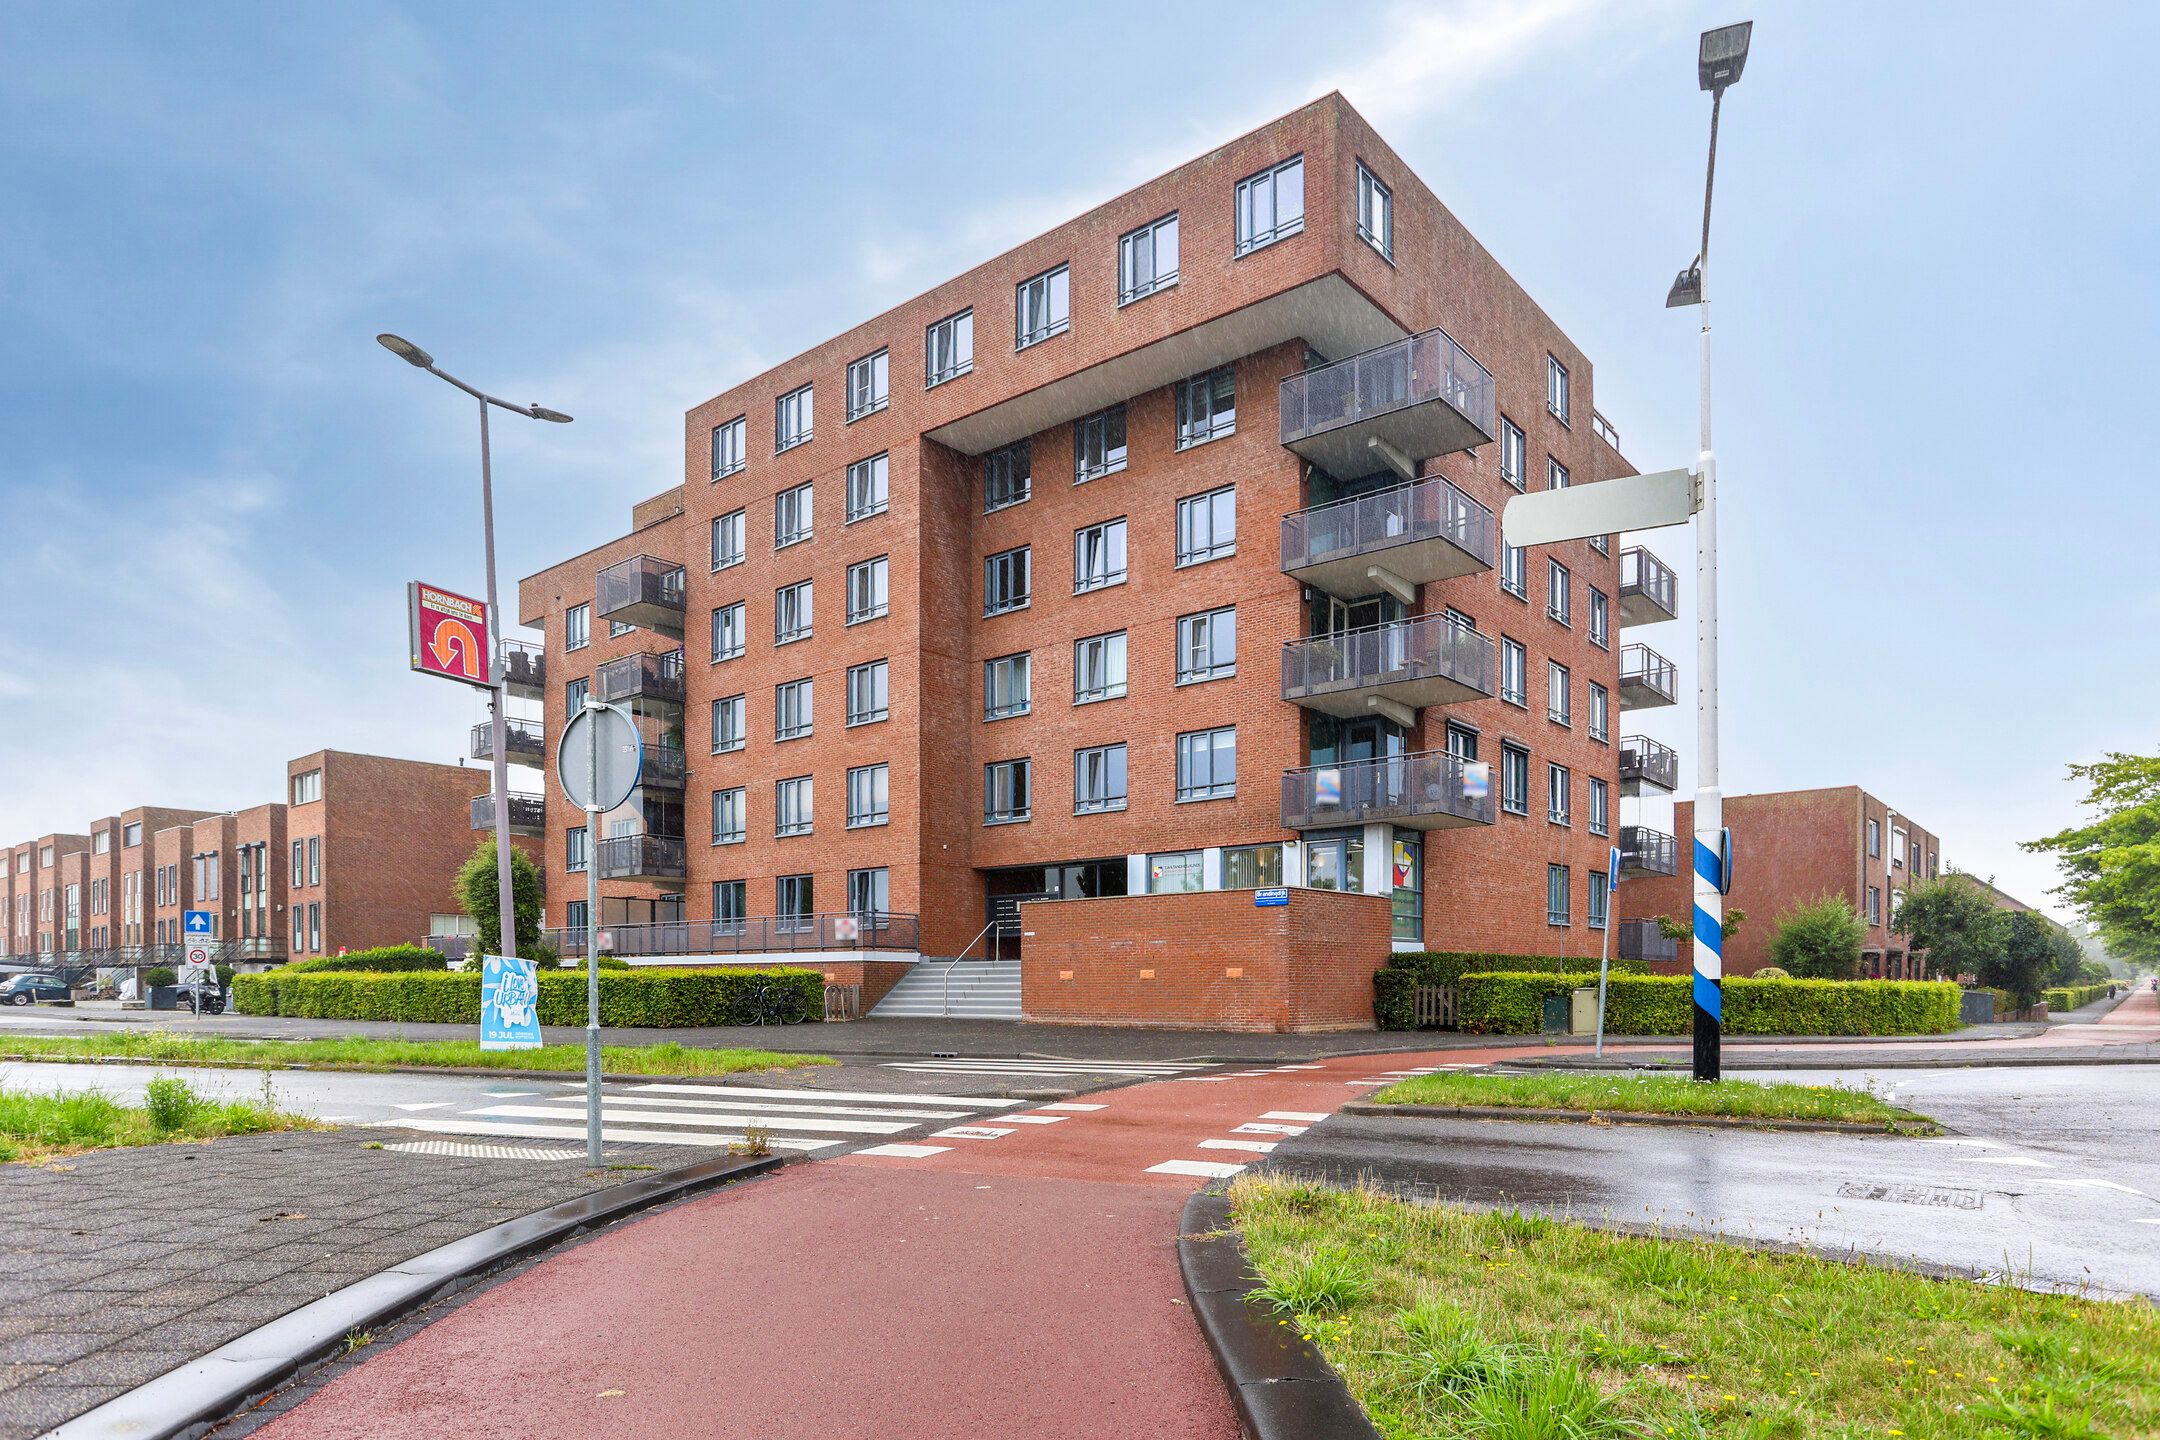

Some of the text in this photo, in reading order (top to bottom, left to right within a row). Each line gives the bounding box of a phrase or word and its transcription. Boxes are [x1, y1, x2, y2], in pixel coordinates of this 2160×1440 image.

[423, 590, 472, 612] HORNBACH
[488, 1030, 497, 1039] 19
[498, 1031, 514, 1039] JUL
